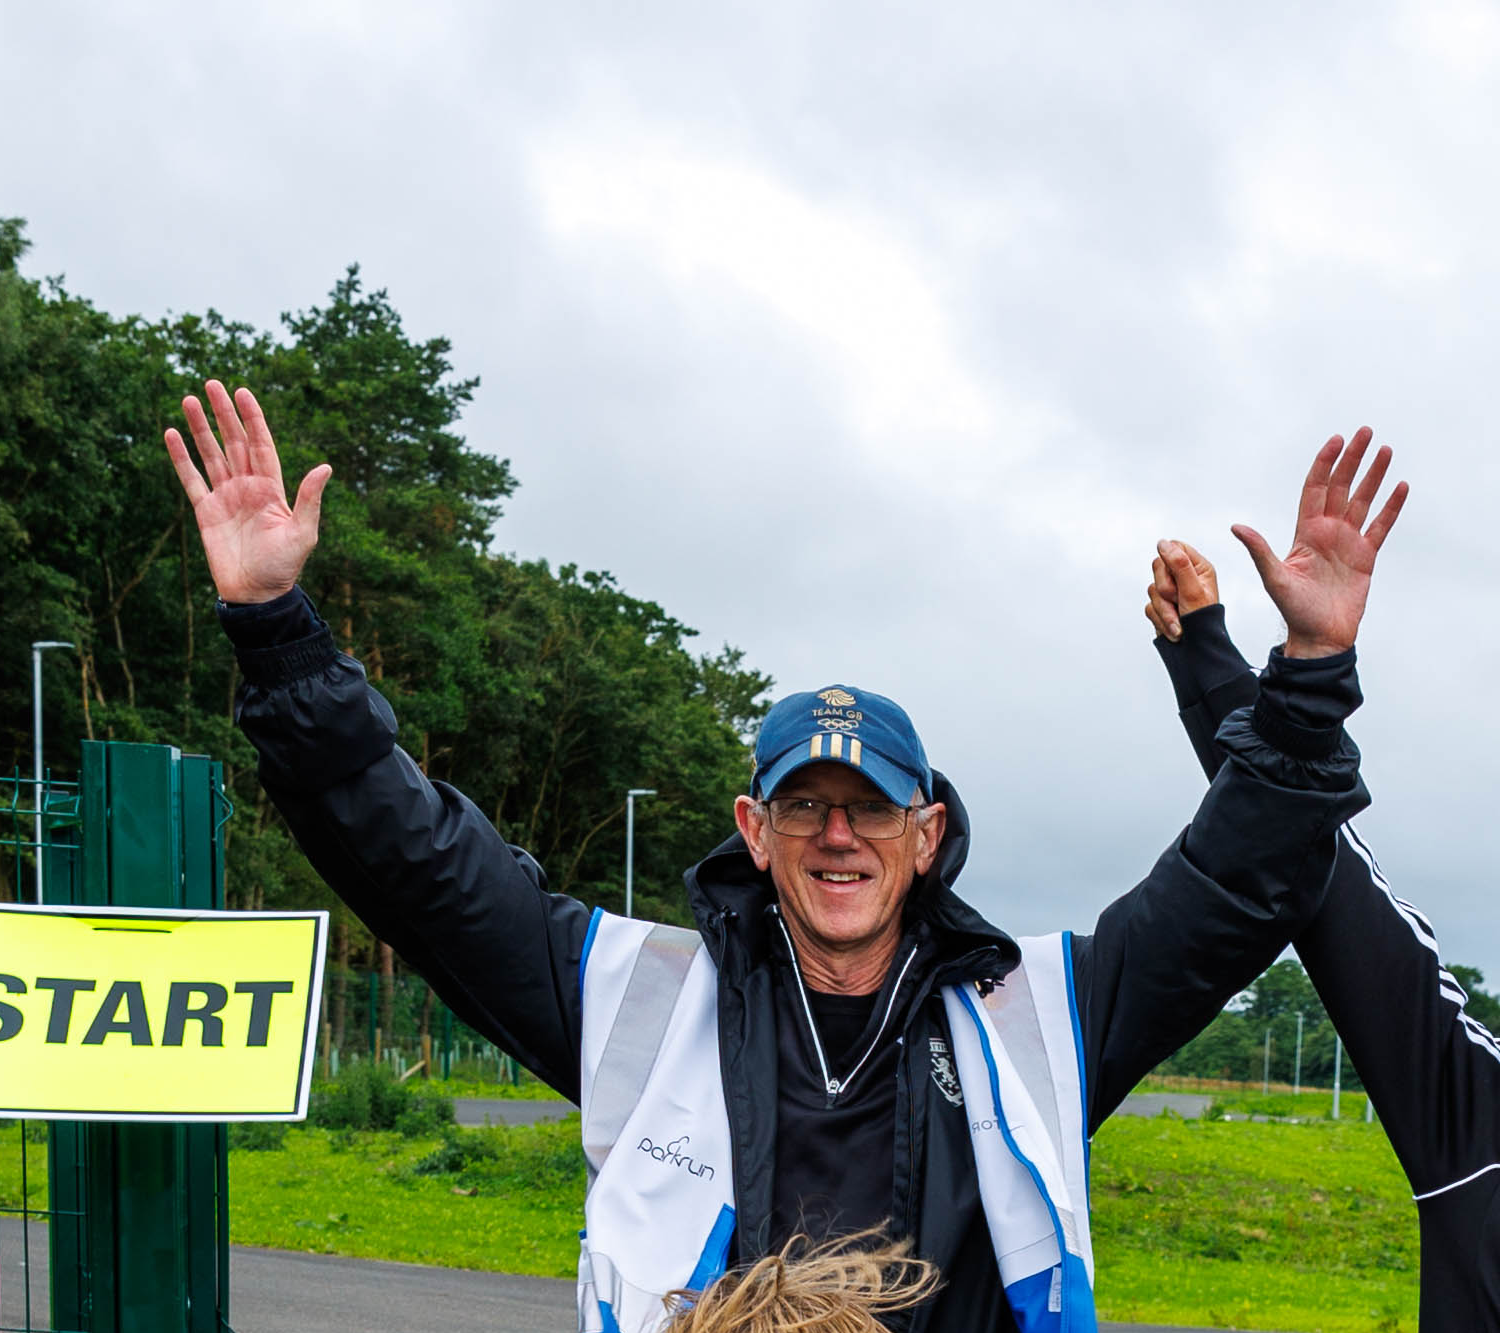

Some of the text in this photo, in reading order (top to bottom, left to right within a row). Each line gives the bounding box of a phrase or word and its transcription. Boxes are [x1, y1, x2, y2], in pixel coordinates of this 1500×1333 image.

[811, 708, 863, 721] TEAM GB
[637, 1135, 715, 1181] parkrun
